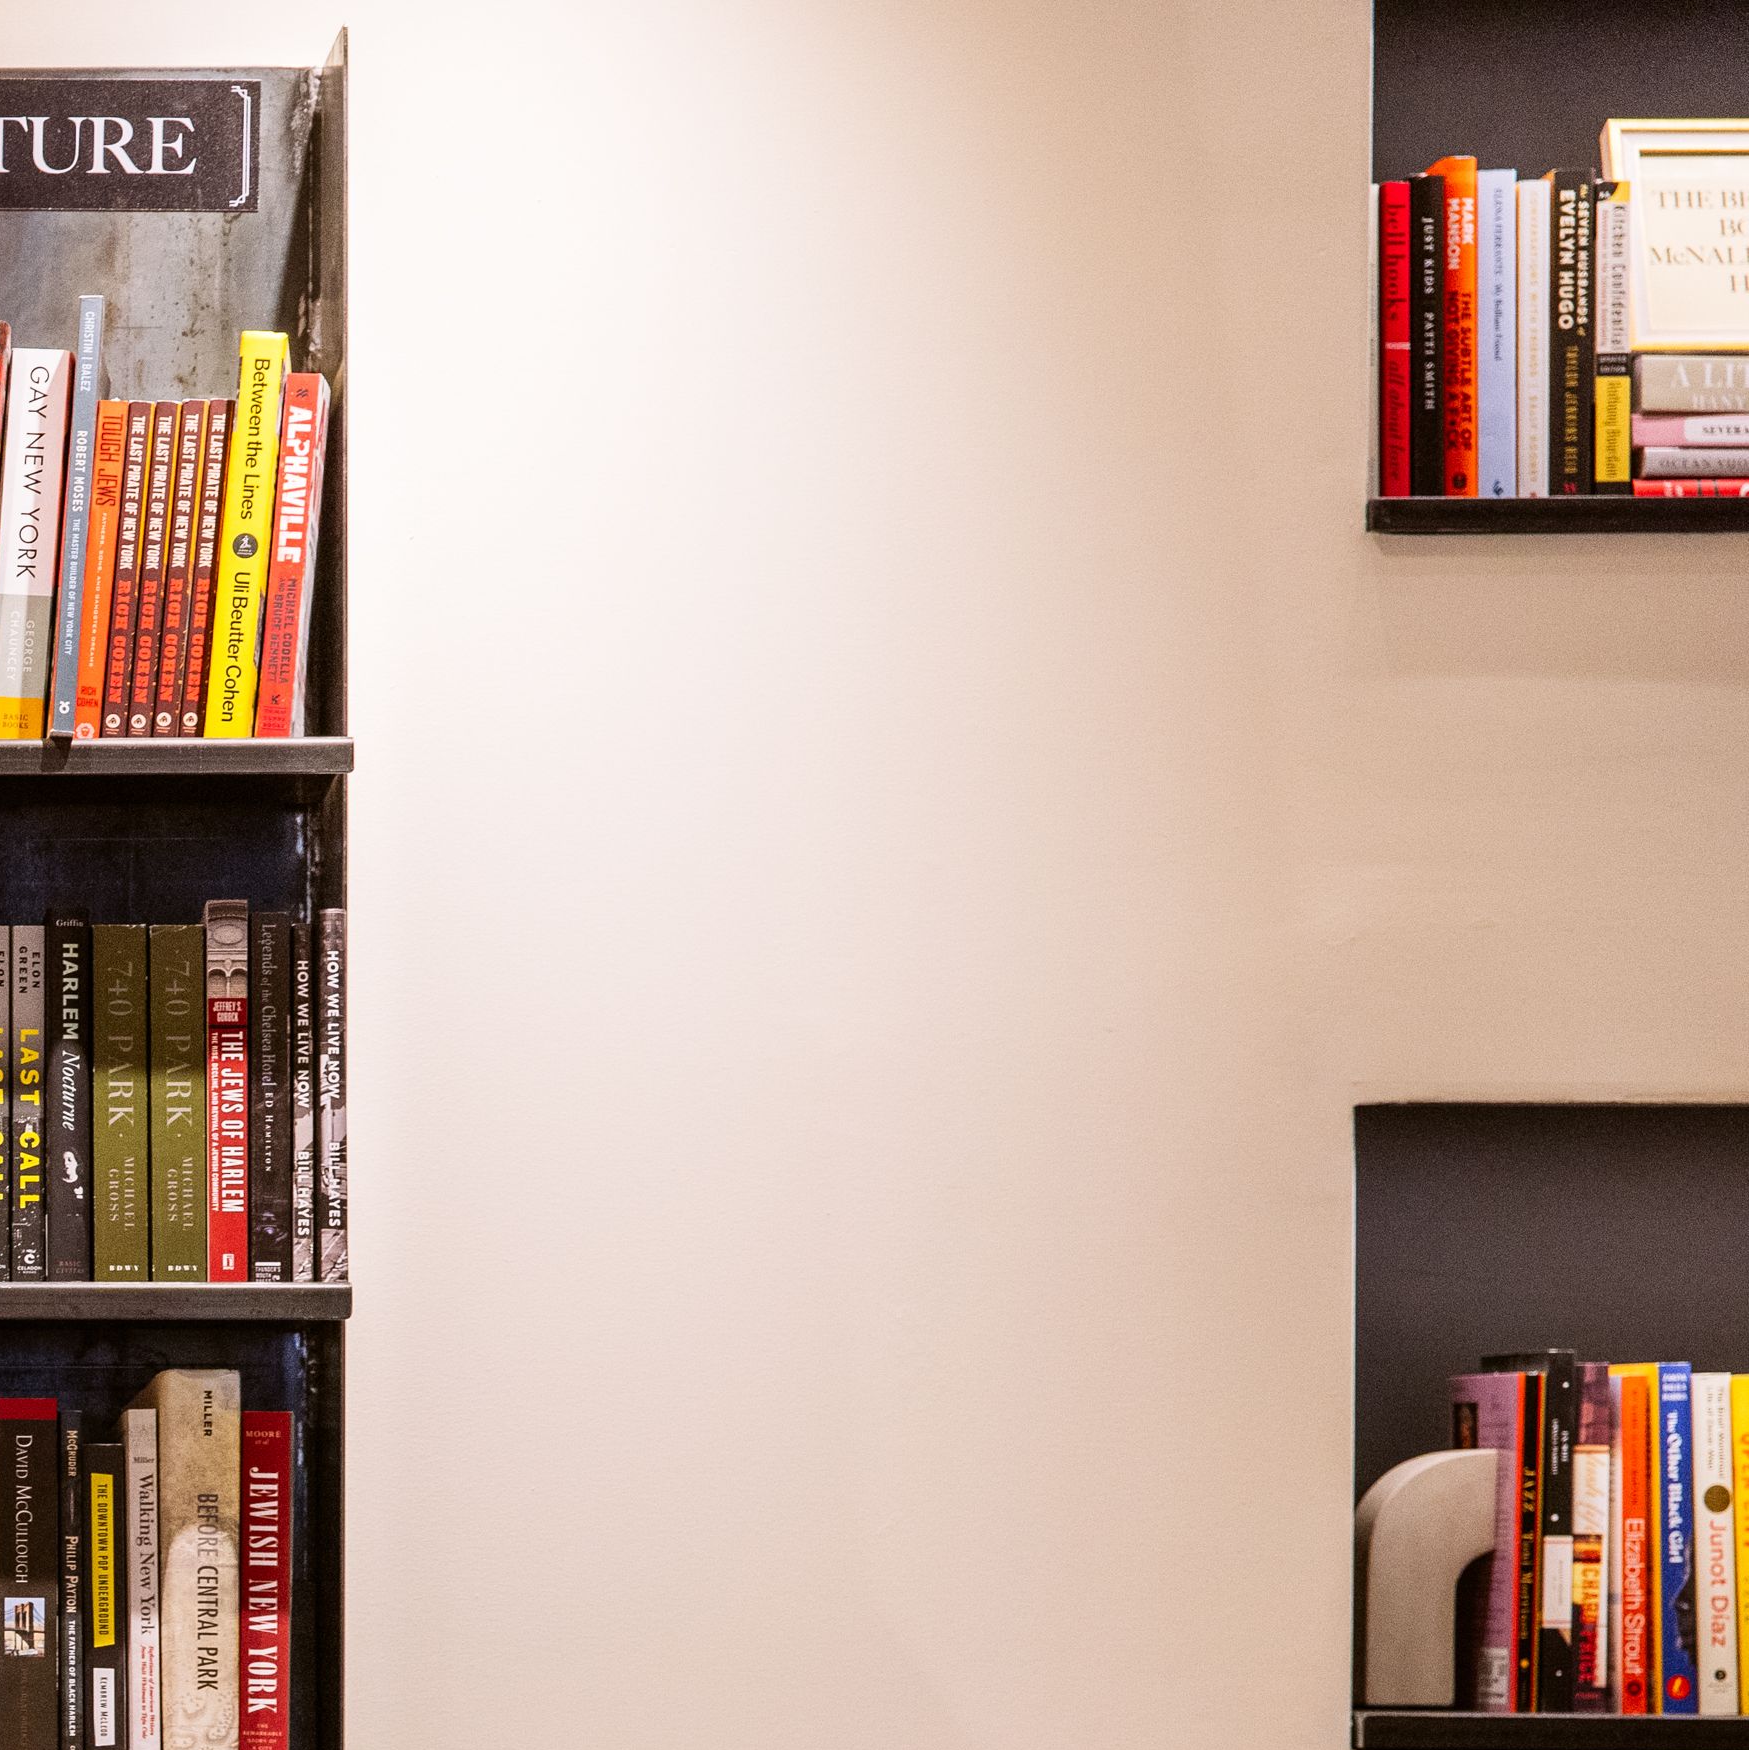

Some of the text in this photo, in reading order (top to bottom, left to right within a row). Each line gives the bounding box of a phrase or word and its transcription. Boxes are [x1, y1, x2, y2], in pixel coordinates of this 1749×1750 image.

[1559, 191, 1575, 329] EVELYN HUGO
[16, 366, 50, 578] GAY NEW YORK
[240, 358, 271, 520] Between the Lines
[276, 405, 312, 563] ALPHAVILLE
[221, 1031, 244, 1213] THE JEWS OF HARLEM
[247, 1467, 279, 1714] JEWISH NEW YORK
